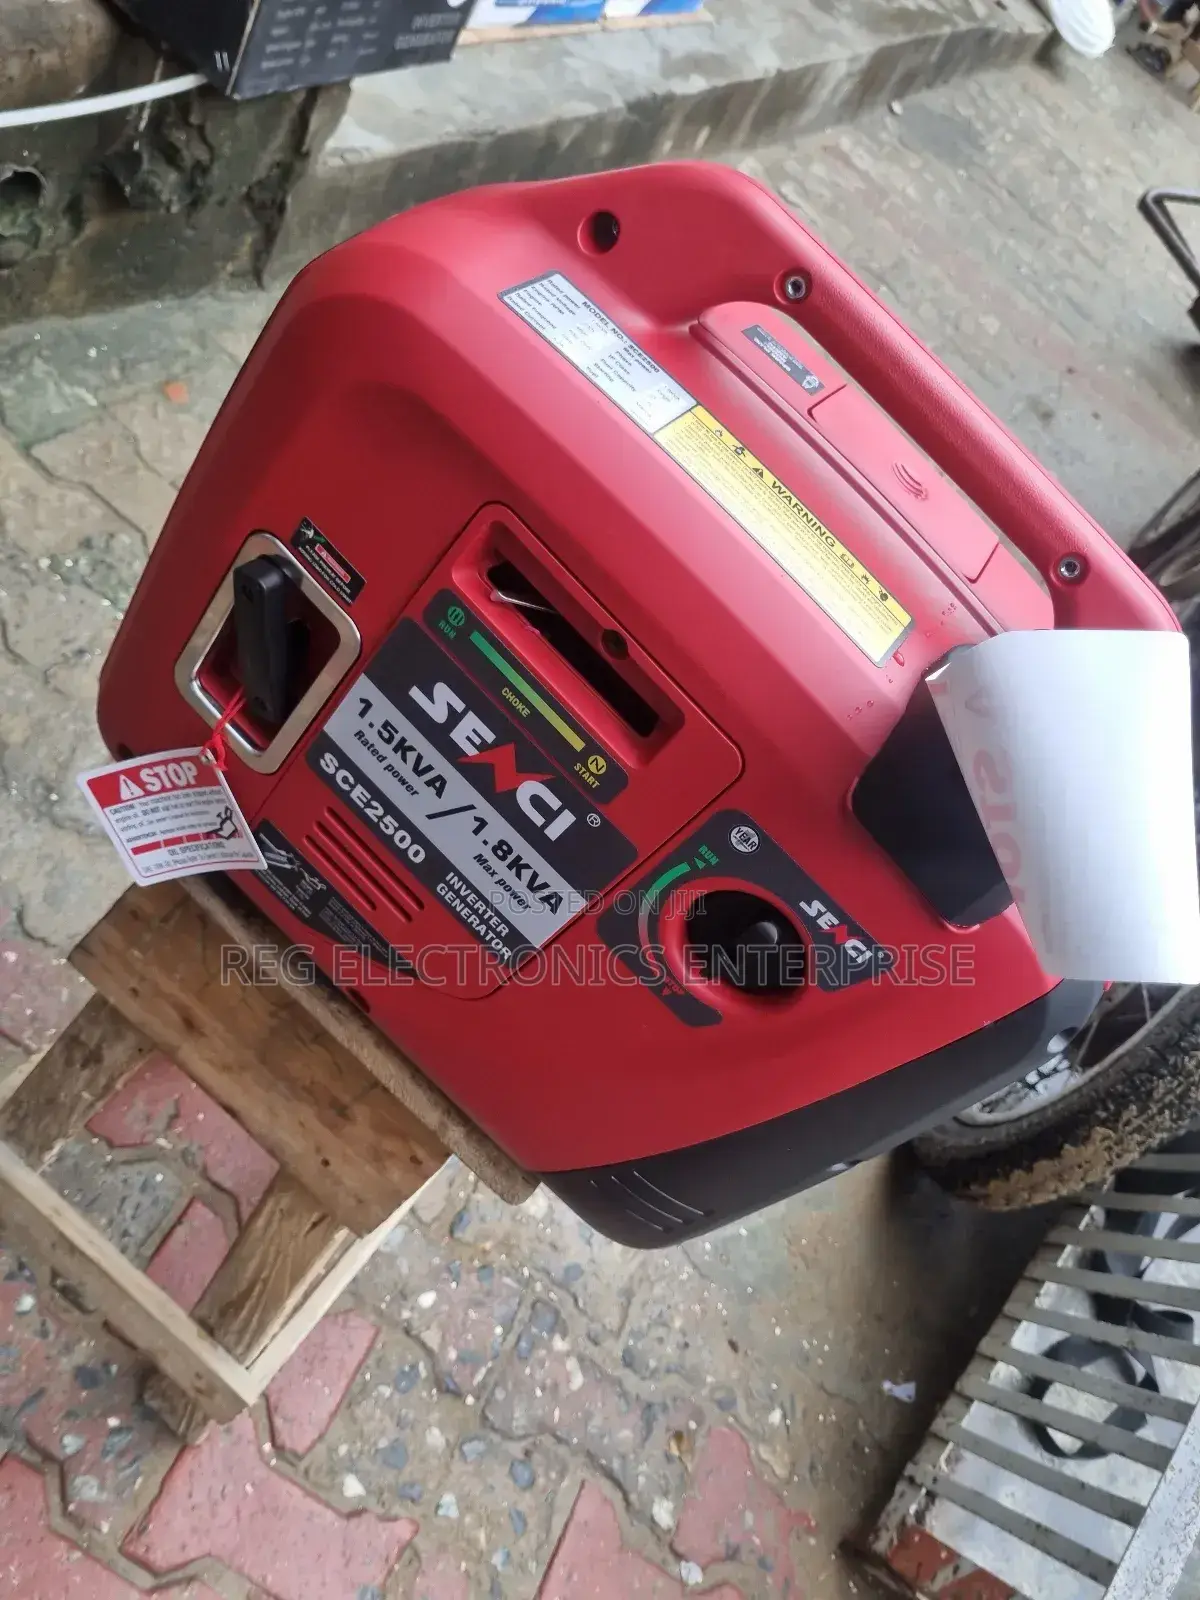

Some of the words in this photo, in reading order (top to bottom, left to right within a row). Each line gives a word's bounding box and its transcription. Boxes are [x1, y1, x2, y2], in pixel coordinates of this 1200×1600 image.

[582, 301, 609, 329] MODEL
[628, 344, 660, 373] SCE2500
[771, 480, 836, 548] WARNING
[439, 621, 457, 640] RUN
[501, 686, 531, 718] CHOKE
[139, 761, 198, 792] STOP
[353, 728, 387, 766] Rated
[383, 761, 420, 797] power
[358, 696, 448, 799] 1.5KVA
[408, 681, 577, 841] SENCI
[573, 762, 600, 790] START
[319, 752, 427, 864] SCE2500
[734, 827, 757, 850] YEAR
[472, 852, 497, 879] Max
[494, 875, 533, 912] power
[698, 844, 719, 866] RUN
[436, 882, 513, 961] GENERATOR
[444, 871, 510, 938] INVERTER
